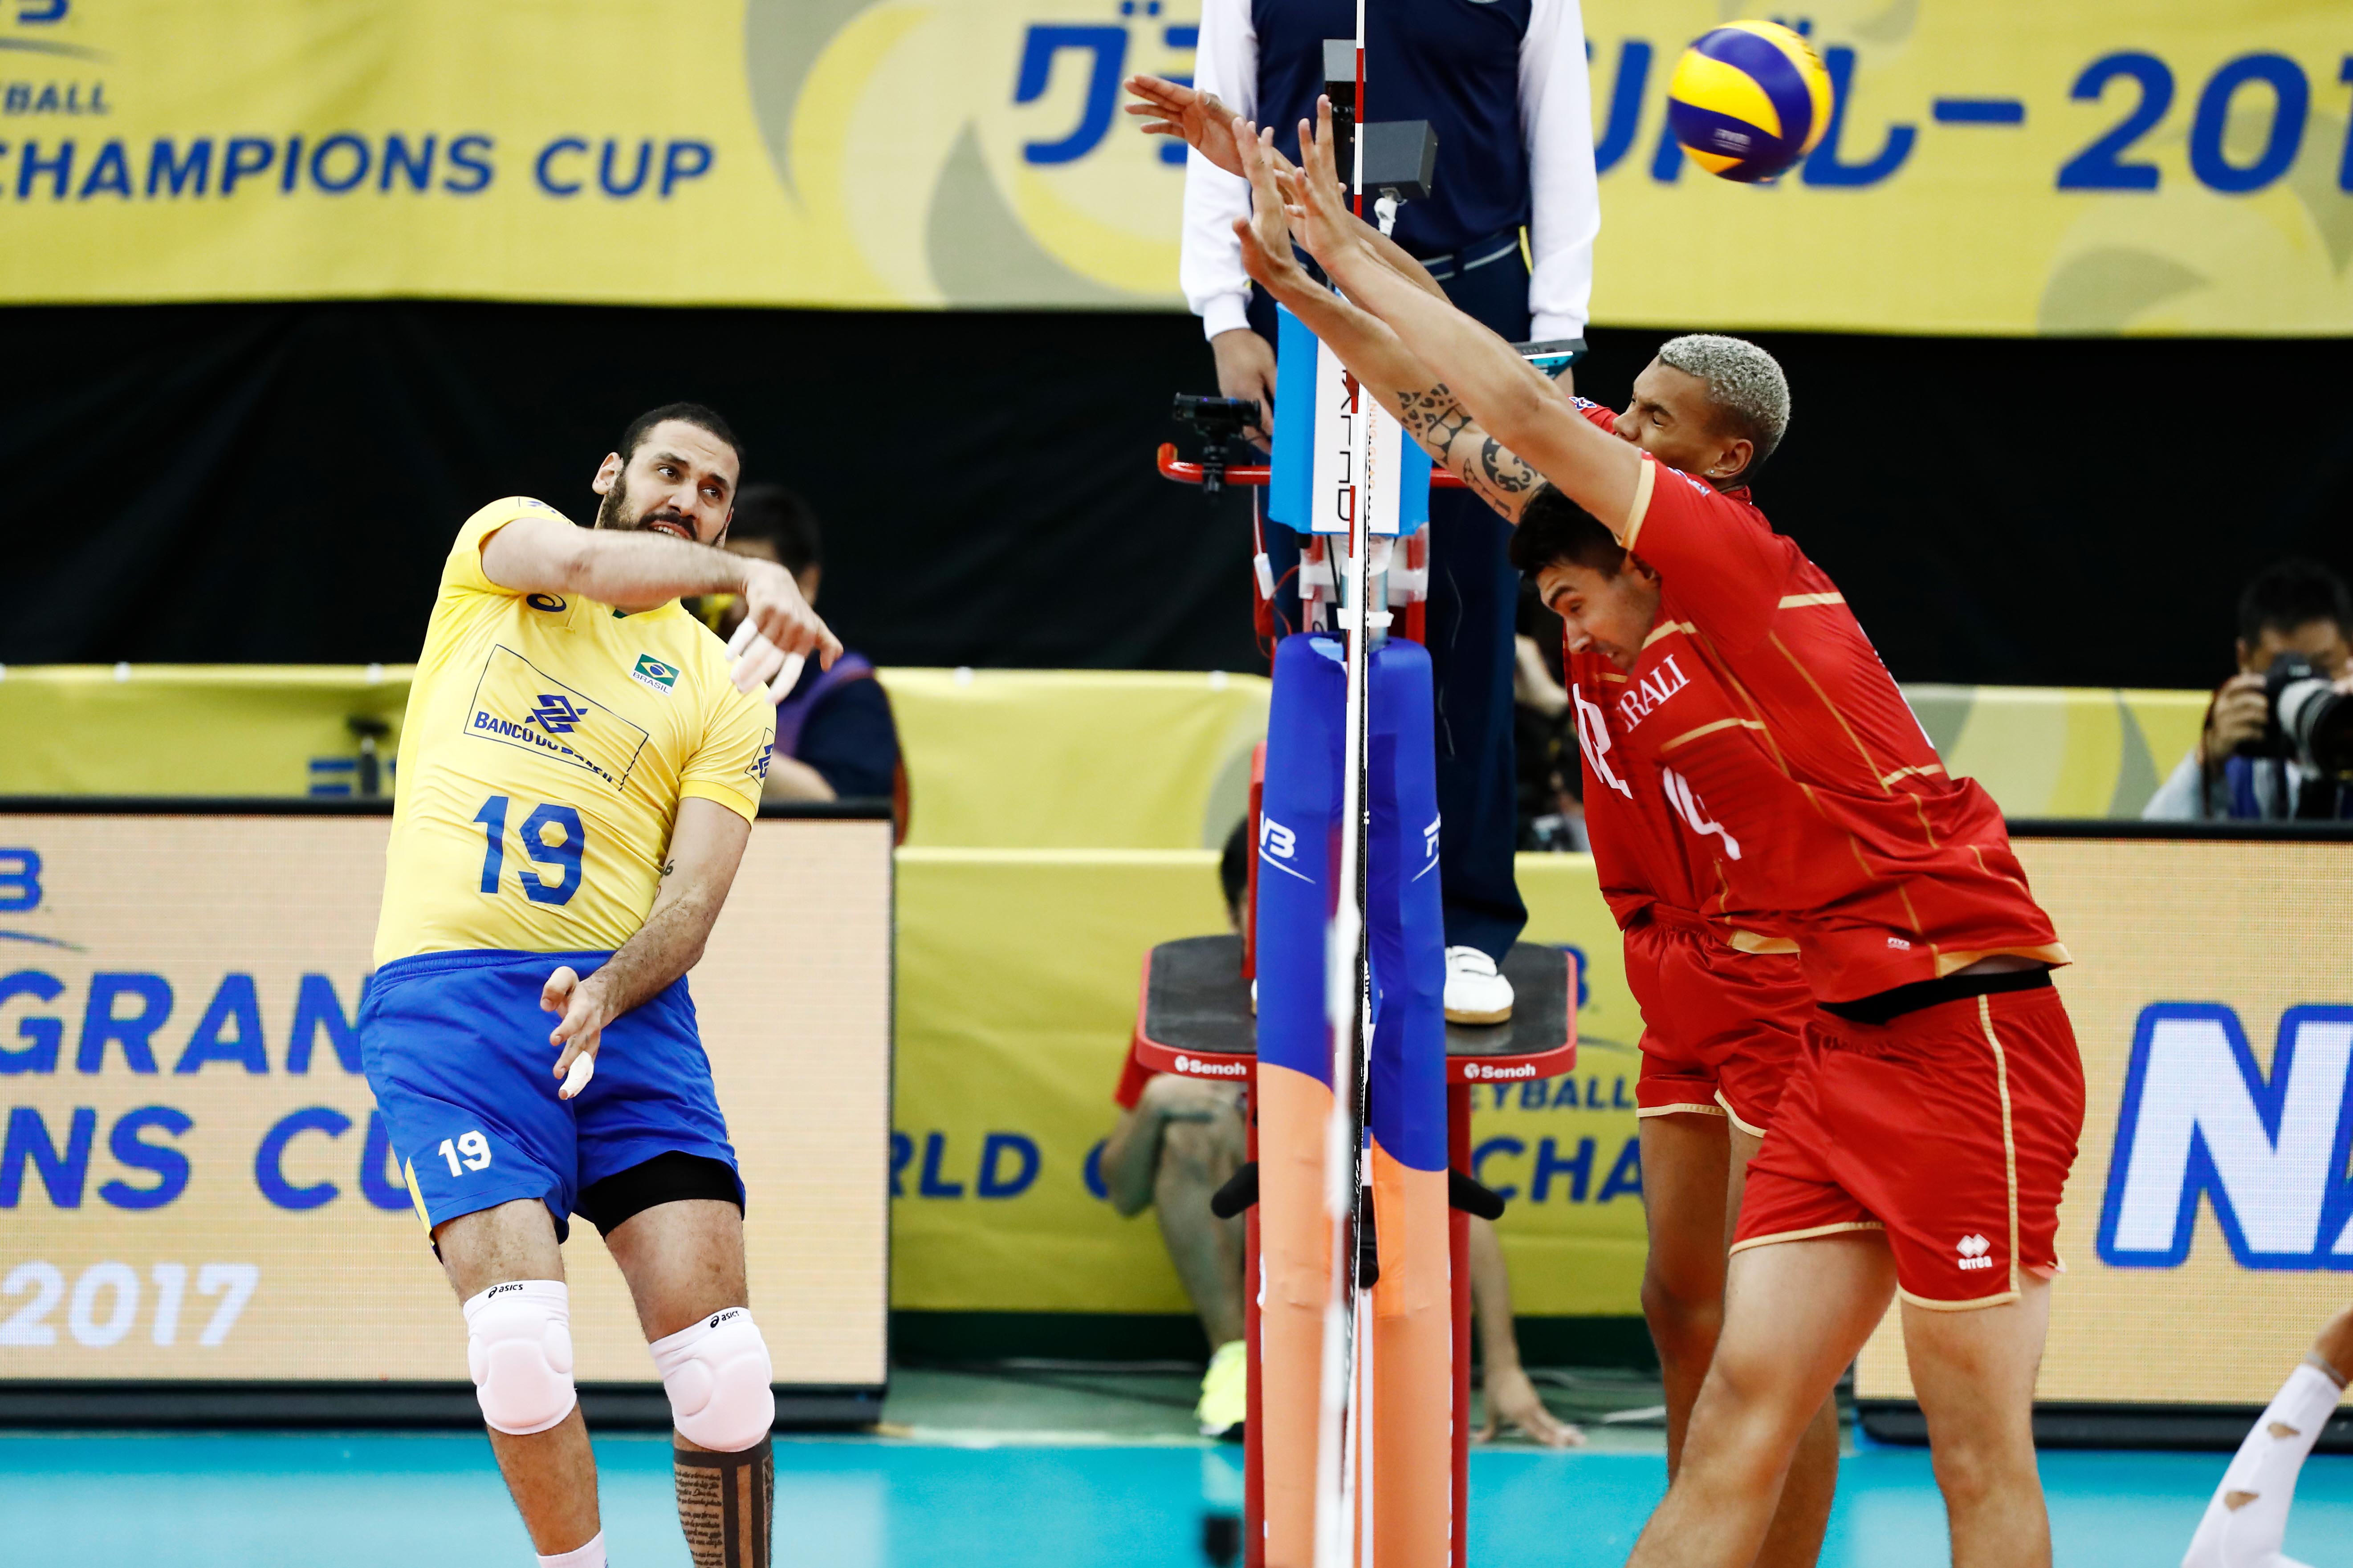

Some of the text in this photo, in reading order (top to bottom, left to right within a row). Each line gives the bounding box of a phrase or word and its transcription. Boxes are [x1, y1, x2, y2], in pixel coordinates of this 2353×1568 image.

[0, 133, 714, 200] HAMPIONS CUP
[633, 672, 669, 694] BRASIL
[474, 711, 533, 742] BANCO
[473, 795, 585, 906] 19
[1189, 1059, 1246, 1076] Senoh
[1481, 1064, 1536, 1078] Senoh
[438, 1129, 492, 1178] 19
[0, 1260, 260, 1348] 2017
